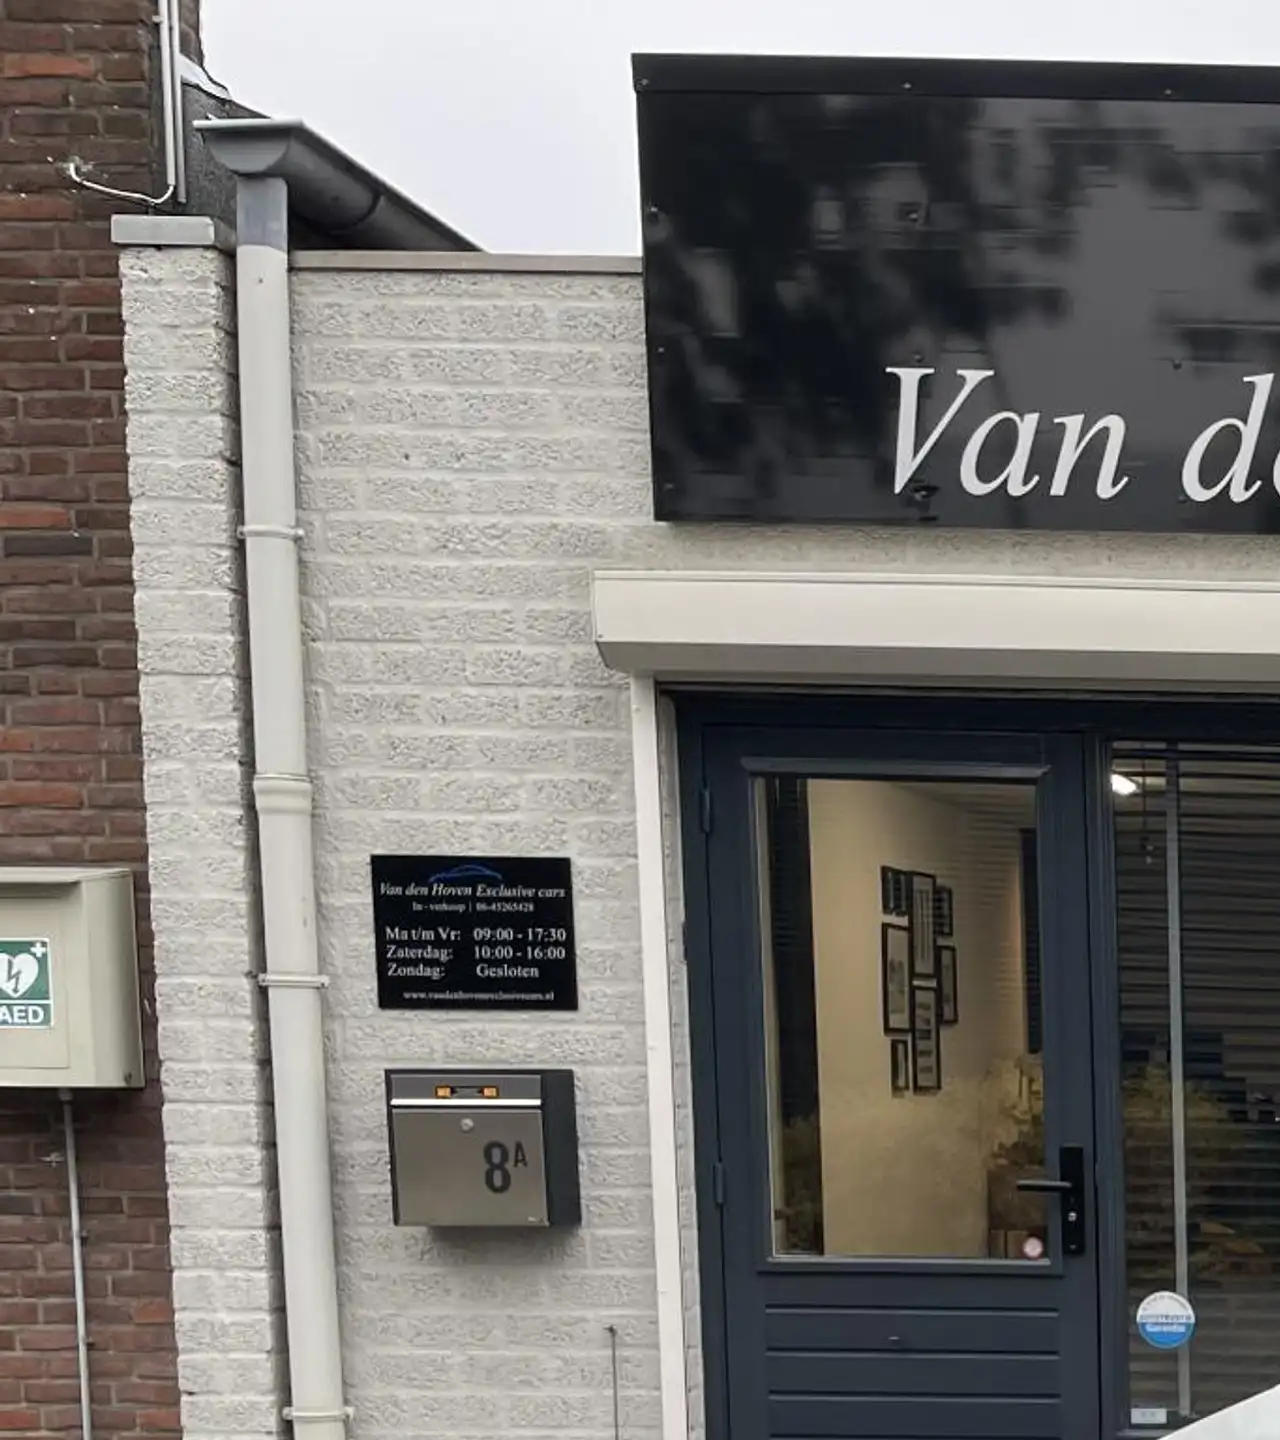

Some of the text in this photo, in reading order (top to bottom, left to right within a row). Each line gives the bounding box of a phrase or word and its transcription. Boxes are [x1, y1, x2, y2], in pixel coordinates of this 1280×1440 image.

[884, 367, 1126, 500] Van
[380, 882, 403, 895] Van
[405, 883, 429, 896] den
[432, 883, 472, 897] Hoven
[476, 884, 536, 898] Exclusive
[411, 927, 434, 941] t/m
[438, 926, 461, 941] Vr:
[473, 927, 513, 942] 09:00
[527, 928, 567, 942] 17:30
[474, 945, 513, 960] 10:00
[527, 946, 566, 960] 16:00
[387, 962, 540, 980] Zondag: Gesloten
[0, 1005, 45, 1024] AED
